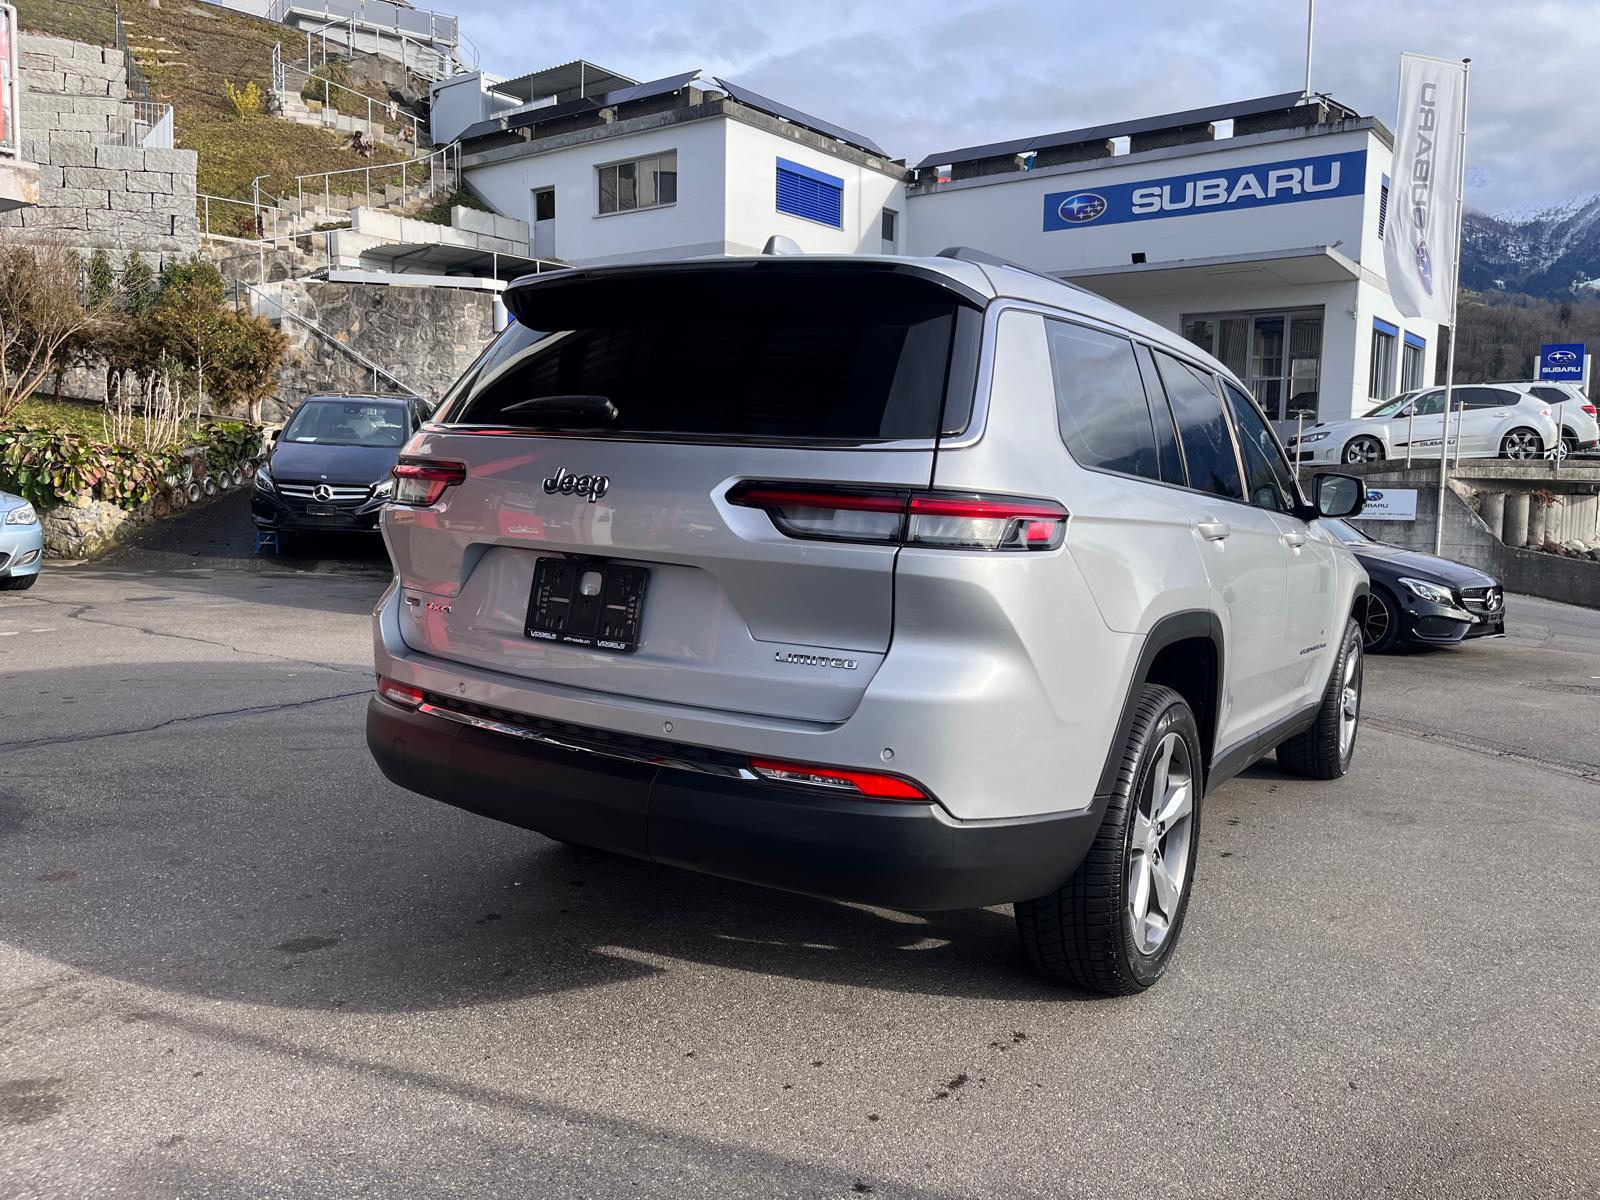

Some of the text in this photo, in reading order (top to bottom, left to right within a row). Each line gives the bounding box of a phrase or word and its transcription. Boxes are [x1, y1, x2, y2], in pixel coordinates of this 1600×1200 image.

[1131, 161, 1341, 214] SUBARU
[542, 467, 610, 503] Jeep
[775, 651, 858, 670] LIMITED
